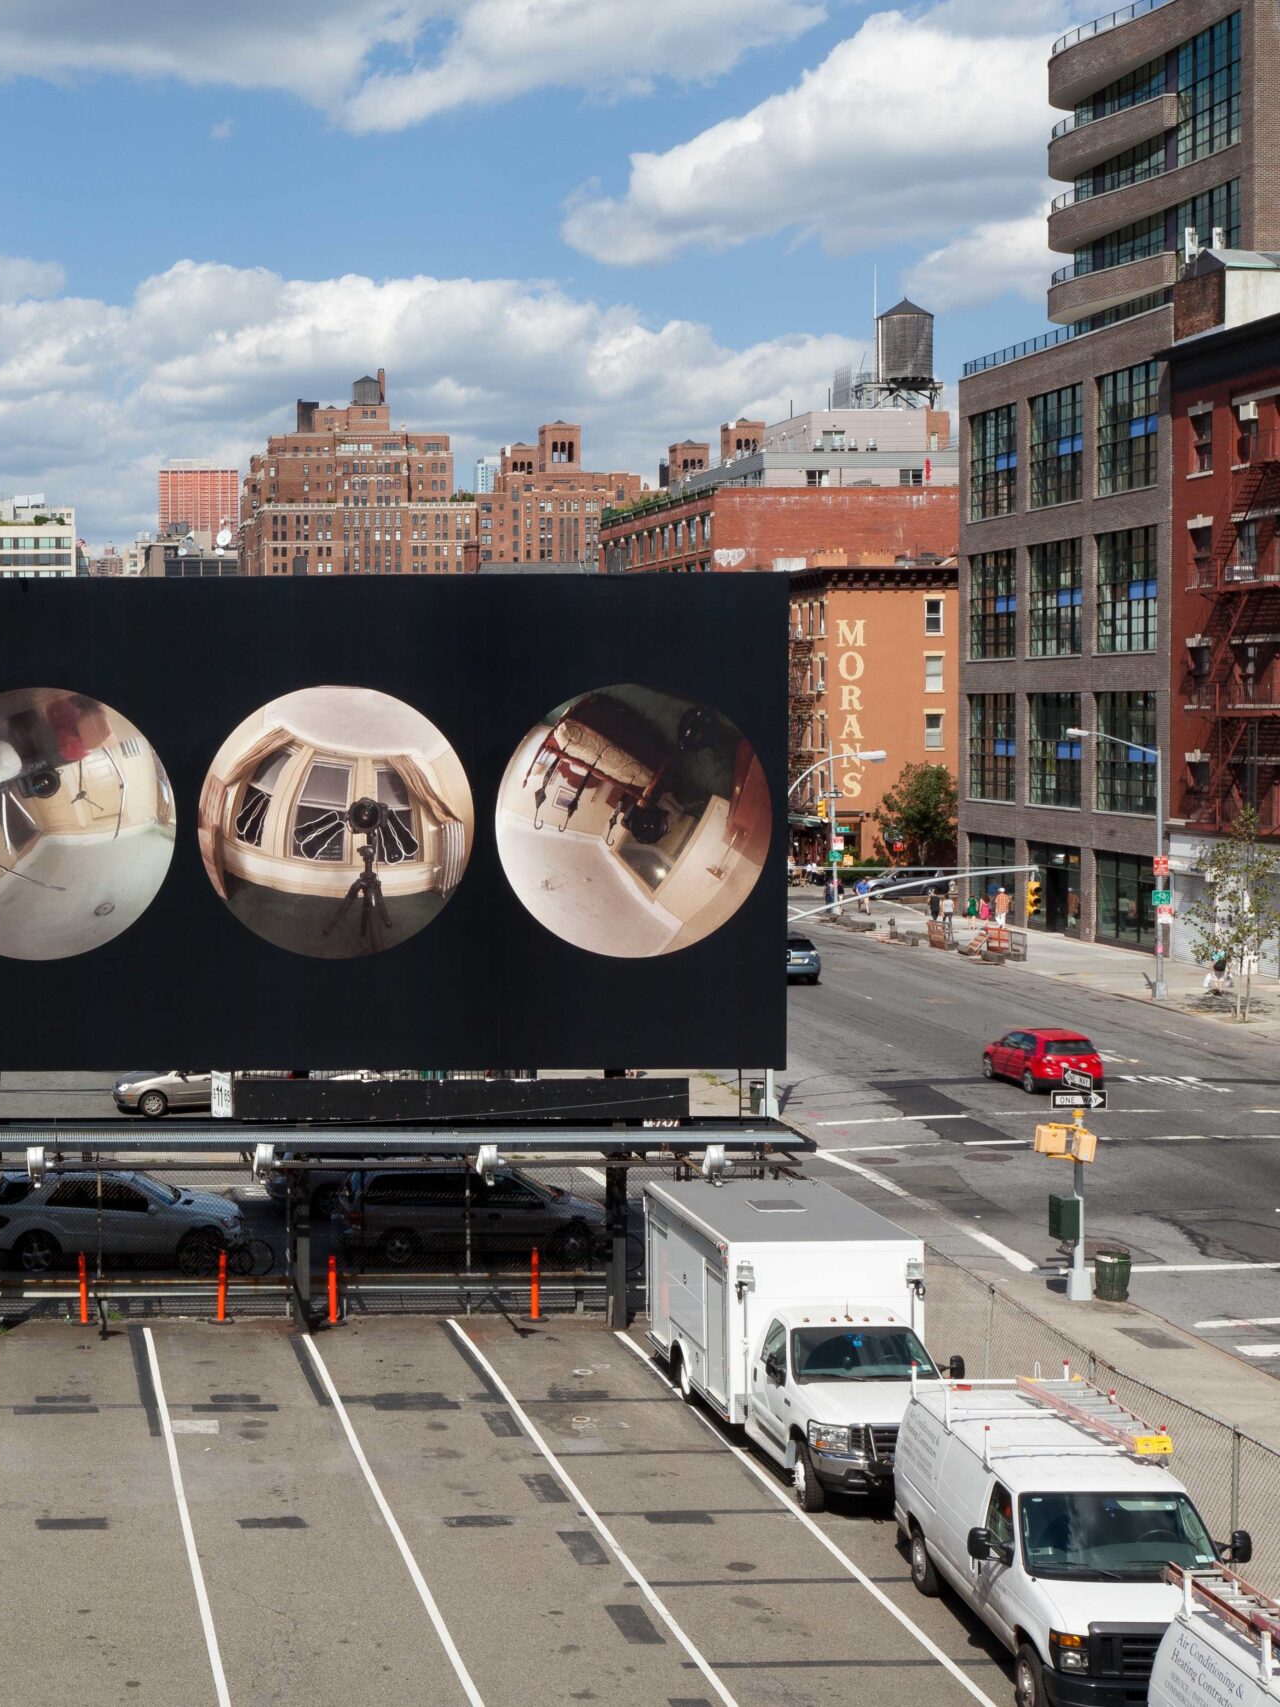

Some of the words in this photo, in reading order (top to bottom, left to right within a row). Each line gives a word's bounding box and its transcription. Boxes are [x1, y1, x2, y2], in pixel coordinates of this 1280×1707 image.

[1067, 1073, 1076, 1083] ONE
[1079, 1076, 1089, 1085] WAY
[1083, 1096, 1099, 1104] WAY
[1171, 1647, 1198, 1682] Heating
[1198, 1672, 1234, 1707] Contracto
[1177, 1633, 1189, 1649] Air
[1189, 1642, 1236, 1692] Conditioning
[1235, 1683, 1244, 1700] &
